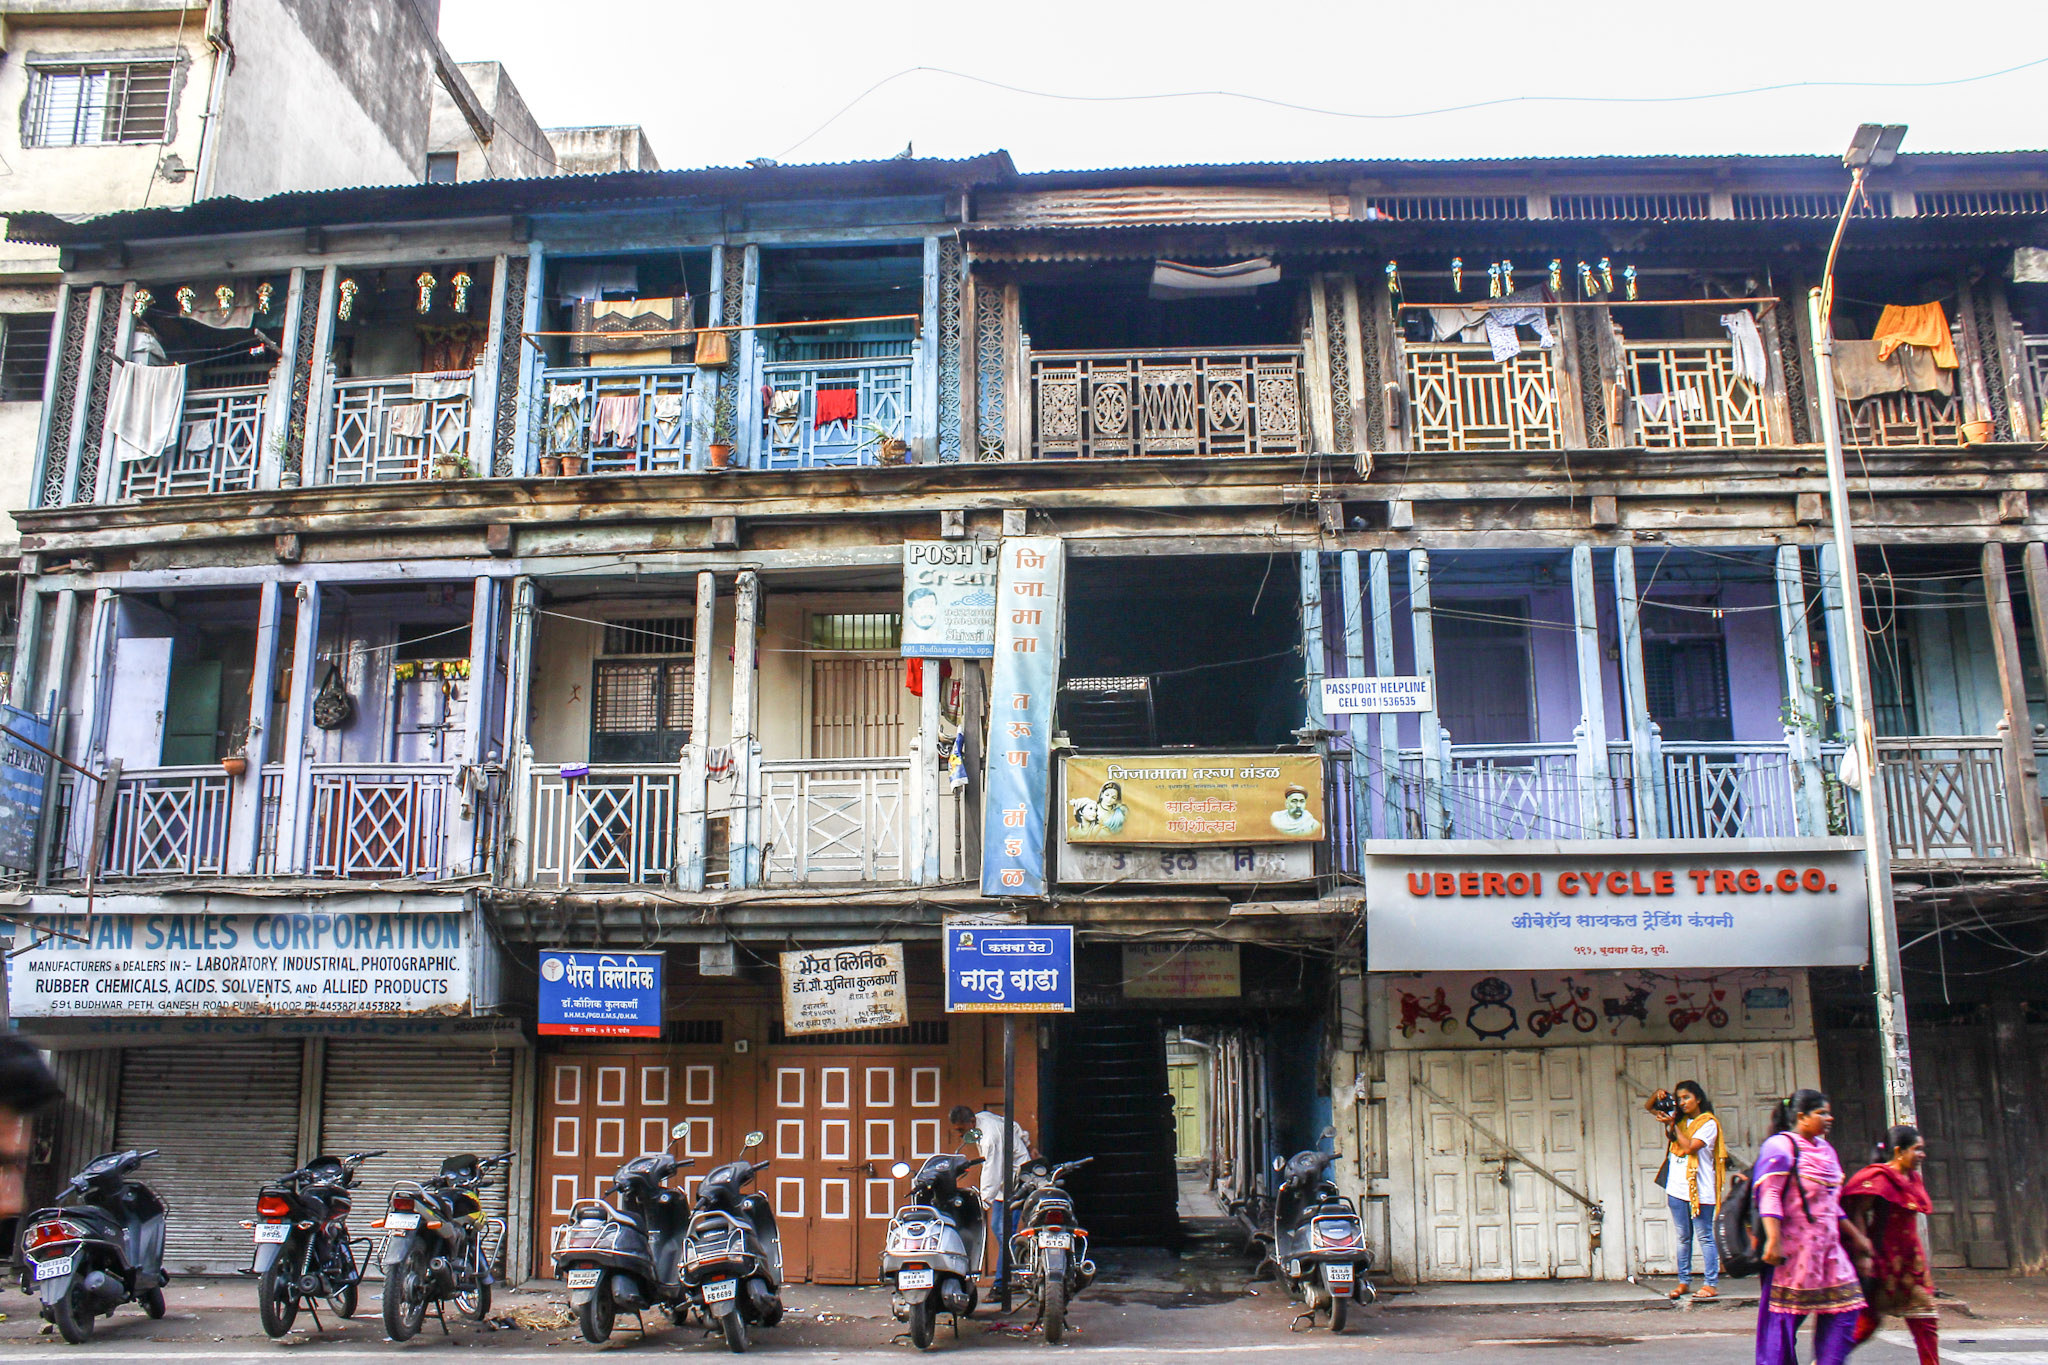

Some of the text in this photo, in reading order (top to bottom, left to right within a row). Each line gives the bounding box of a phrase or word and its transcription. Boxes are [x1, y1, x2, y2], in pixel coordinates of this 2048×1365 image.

[910, 545, 973, 565] POSH
[946, 629, 984, 642] Shivaji
[919, 645, 955, 653] Budhawar
[1326, 682, 1427, 695] PASSPORT HELPLINE
[1339, 696, 1416, 707] CELL 9011536535
[1107, 763, 1281, 780] जिजामाता तरूण मंडळ
[1166, 797, 1237, 813] सार्वजनिक
[1167, 817, 1236, 833] गणेशोत्सव
[1408, 872, 1542, 896] UBEROI
[1558, 871, 1675, 896] CYCLE
[1511, 910, 1734, 931] ओबेरॉय सायकल ट्रेडिंग कंपनी
[30, 914, 461, 950] CHETAN SALES CORPORATION
[988, 943, 1026, 953] कसबा
[1028, 940, 1046, 953] पेठ
[29, 961, 111, 972] MANUFACTURERS
[123, 961, 166, 972] DEALERS
[799, 950, 888, 975] भैरव क्लिनिक
[566, 955, 655, 989] भैरव क्लिनिक
[1009, 968, 1060, 991] वाडा
[36, 979, 89, 993] RUBBER
[296, 985, 317, 994] AND
[323, 979, 368, 994] ALLIED
[374, 979, 448, 994] PRODUCTS
[856, 971, 898, 991] कुलकर्णी
[75, 1001, 122, 1009] BUDHWAR
[158, 1001, 199, 1010] GANESH
[203, 1001, 230, 1010] ROAD
[604, 998, 638, 1011] कुलकर्णी
[38, 1265, 70, 1279] 9510
